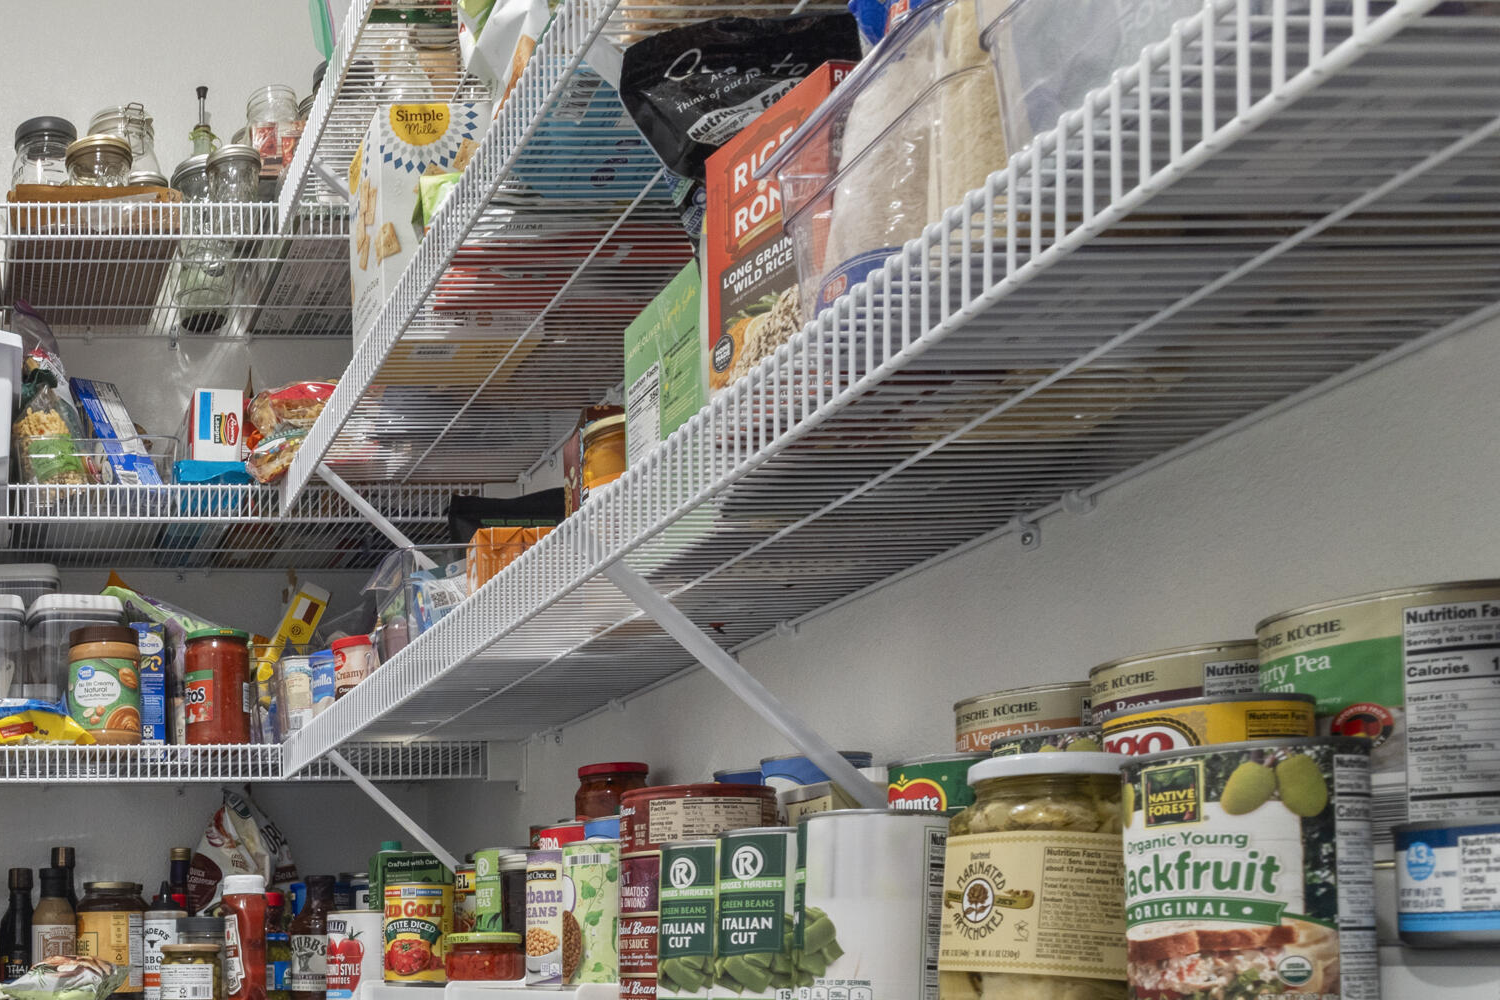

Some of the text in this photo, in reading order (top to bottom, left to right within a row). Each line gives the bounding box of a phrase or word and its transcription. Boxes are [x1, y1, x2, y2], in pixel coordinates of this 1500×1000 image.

[396, 110, 444, 125] Simple
[404, 123, 438, 135] Mills
[723, 236, 793, 290] LONG GRAIN
[733, 250, 793, 295] WILD RICE
[1406, 606, 1477, 625] Nutrition
[1406, 637, 1443, 647] Serving
[1445, 634, 1464, 643] size
[1476, 632, 1493, 642] cup
[1294, 654, 1332, 676] Pea
[1407, 663, 1470, 678] Calories
[336, 668, 365, 681] Creamy
[1249, 711, 1284, 720] Nutrition
[1147, 788, 1195, 803] NATIVE
[1148, 802, 1197, 817] FOREST
[1127, 832, 1249, 854] Organic Young
[1082, 851, 1101, 859] Facts
[1461, 846, 1492, 856] Facts
[956, 861, 1007, 891] MARINATED
[1111, 878, 1124, 887] 110
[743, 879, 783, 888] MARKETS
[679, 888, 714, 896] MARKETS
[403, 901, 444, 917] GOLD
[680, 906, 707, 914] BEANS
[722, 899, 775, 909] GREEN BEANS
[1135, 903, 1230, 919] ORIGINAL
[388, 921, 435, 932] PETITE DICED
[662, 922, 705, 934] ITALIAN
[722, 917, 773, 930] ITALIAN
[952, 909, 1004, 941] ARTICHOKES
[629, 939, 648, 949] SAUCE
[669, 937, 692, 948] CUT
[731, 932, 758, 945] CUT
[341, 964, 360, 976] STYLE
[781, 991, 791, 1000] 15
